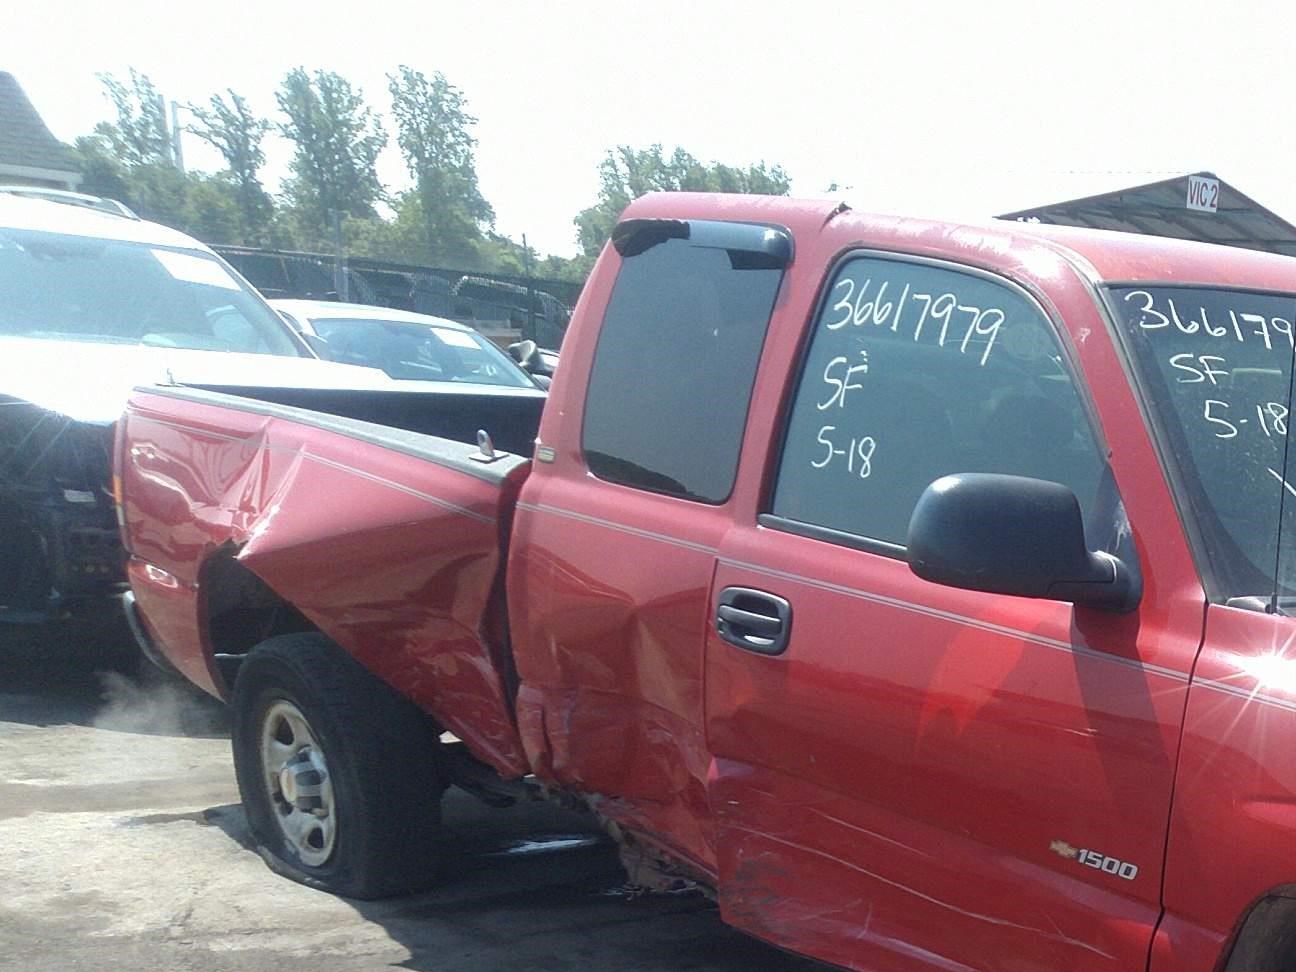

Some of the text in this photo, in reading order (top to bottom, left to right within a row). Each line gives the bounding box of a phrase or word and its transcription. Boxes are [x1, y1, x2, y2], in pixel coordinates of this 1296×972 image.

[1189, 180, 1218, 208] VIC 2
[827, 278, 1005, 366] 36617979
[817, 356, 868, 410] SF
[1169, 353, 1231, 385] SF
[1204, 399, 1289, 439] 5-18
[811, 425, 876, 479] 5-18
[1078, 848, 1138, 880] 1500
